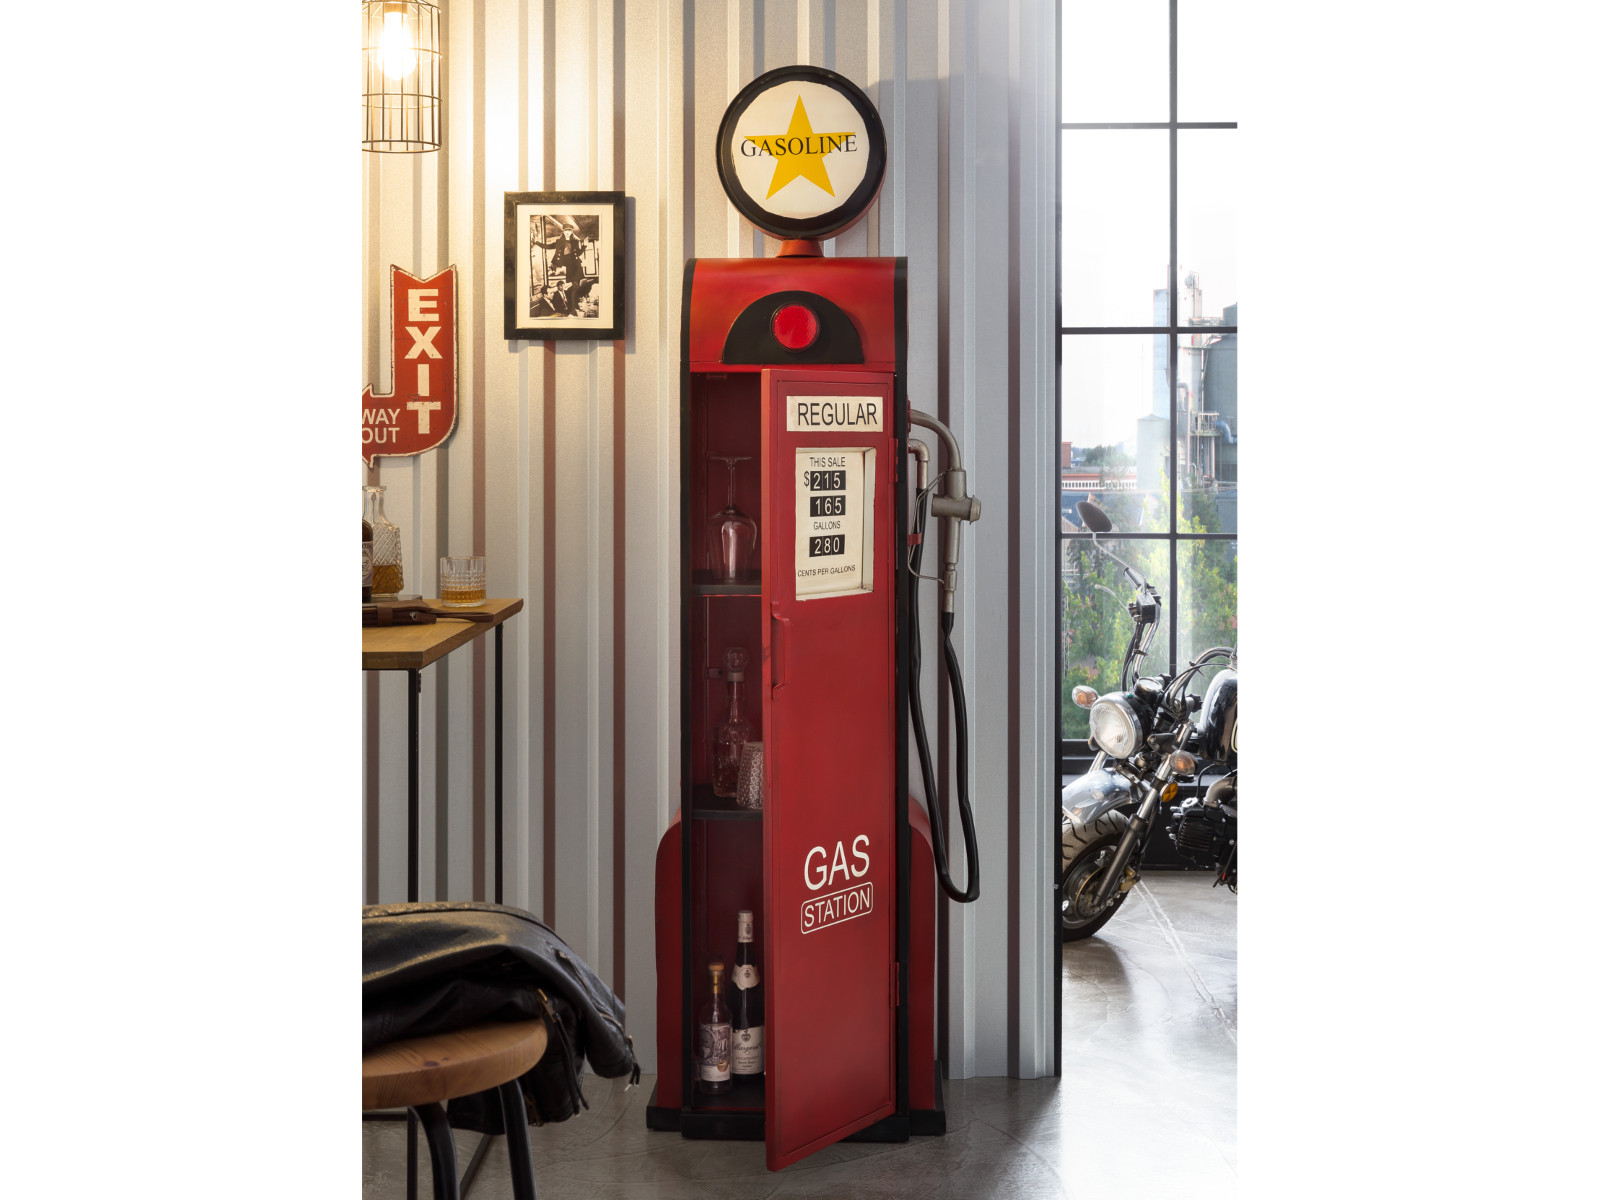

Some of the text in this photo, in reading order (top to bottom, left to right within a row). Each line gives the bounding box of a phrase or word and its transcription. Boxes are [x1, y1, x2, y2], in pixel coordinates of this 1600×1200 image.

[741, 134, 858, 157] GASOLINE
[404, 288, 443, 435] EXIT
[362, 408, 401, 425] WAY
[797, 402, 878, 426] REGULAR
[362, 427, 401, 444] OUT
[809, 457, 846, 468] THIS SALE
[815, 497, 842, 515] 165
[813, 521, 841, 531] GALLONS
[814, 537, 840, 555] 280
[797, 564, 856, 578] CENTS PER GALLONS
[804, 834, 870, 891] GAS
[804, 887, 870, 928] STATION
